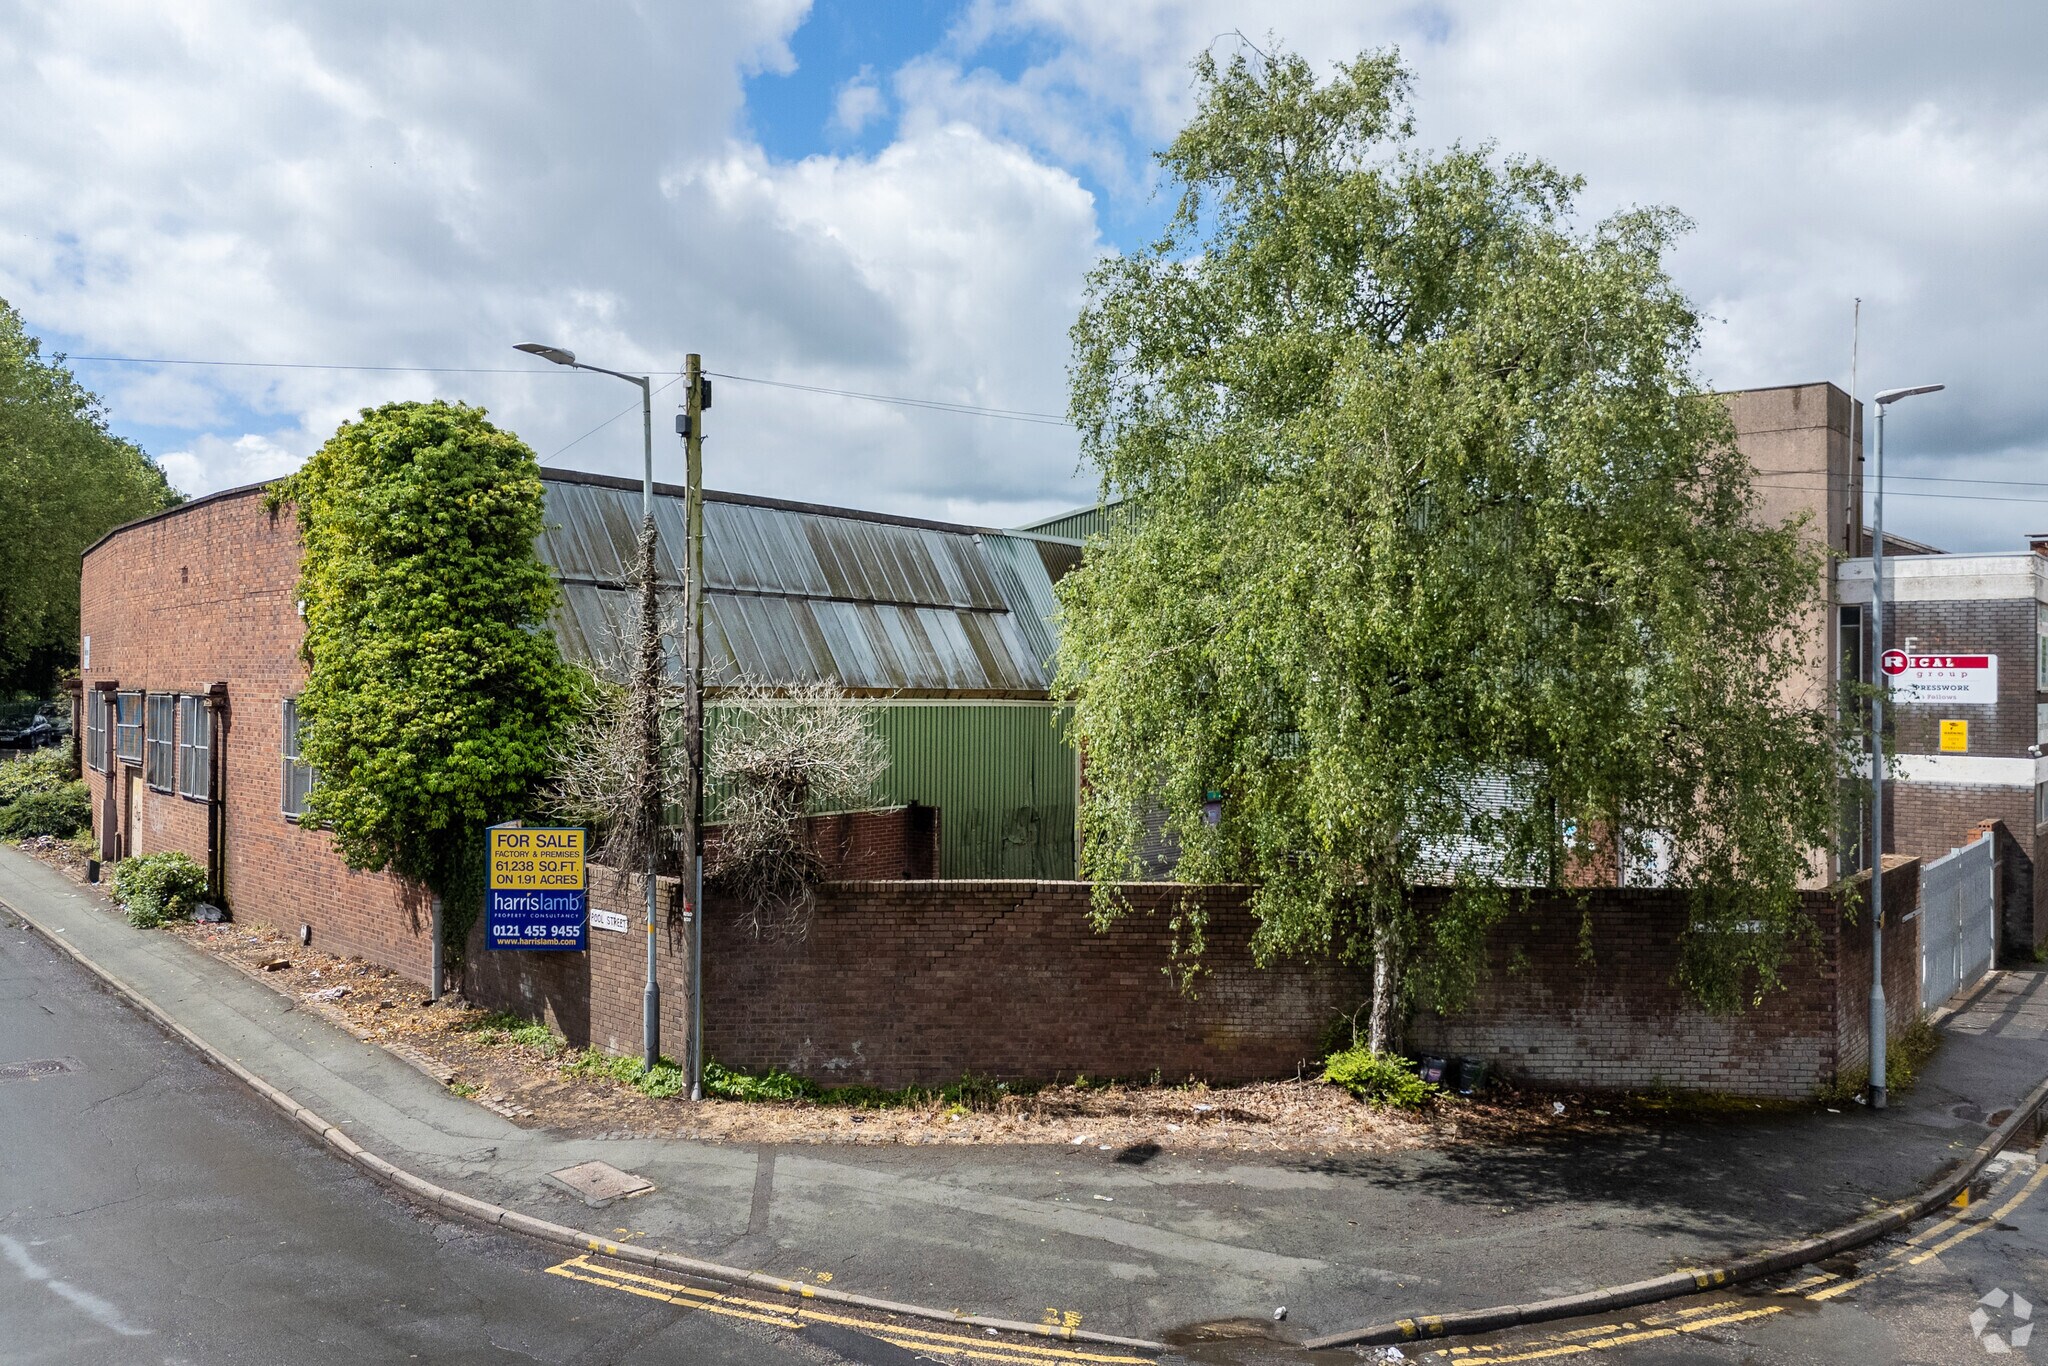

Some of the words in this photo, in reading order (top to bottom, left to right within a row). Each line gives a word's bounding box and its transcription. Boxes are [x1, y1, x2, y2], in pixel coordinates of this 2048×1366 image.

[1884, 656, 1955, 668] RICAL
[1915, 684, 1969, 692] PRESSWORK
[497, 834, 529, 848] FOR
[536, 834, 577, 848] SALE
[495, 850, 529, 858] FACTORY
[532, 850, 538, 858] &
[540, 850, 580, 858] PREMISES
[496, 860, 534, 873] 61,238
[539, 860, 579, 873] SQ.FT.
[496, 874, 513, 884] ON
[517, 874, 536, 884] 1.91
[540, 874, 578, 885] ACRES
[494, 892, 579, 911] harrislamb
[591, 912, 604, 924] POOL
[607, 915, 626, 928] STREET
[493, 925, 520, 936] 0121
[524, 925, 547, 937] 455
[551, 925, 580, 937] 9455
[497, 938, 576, 946] www.harrislamb.com
